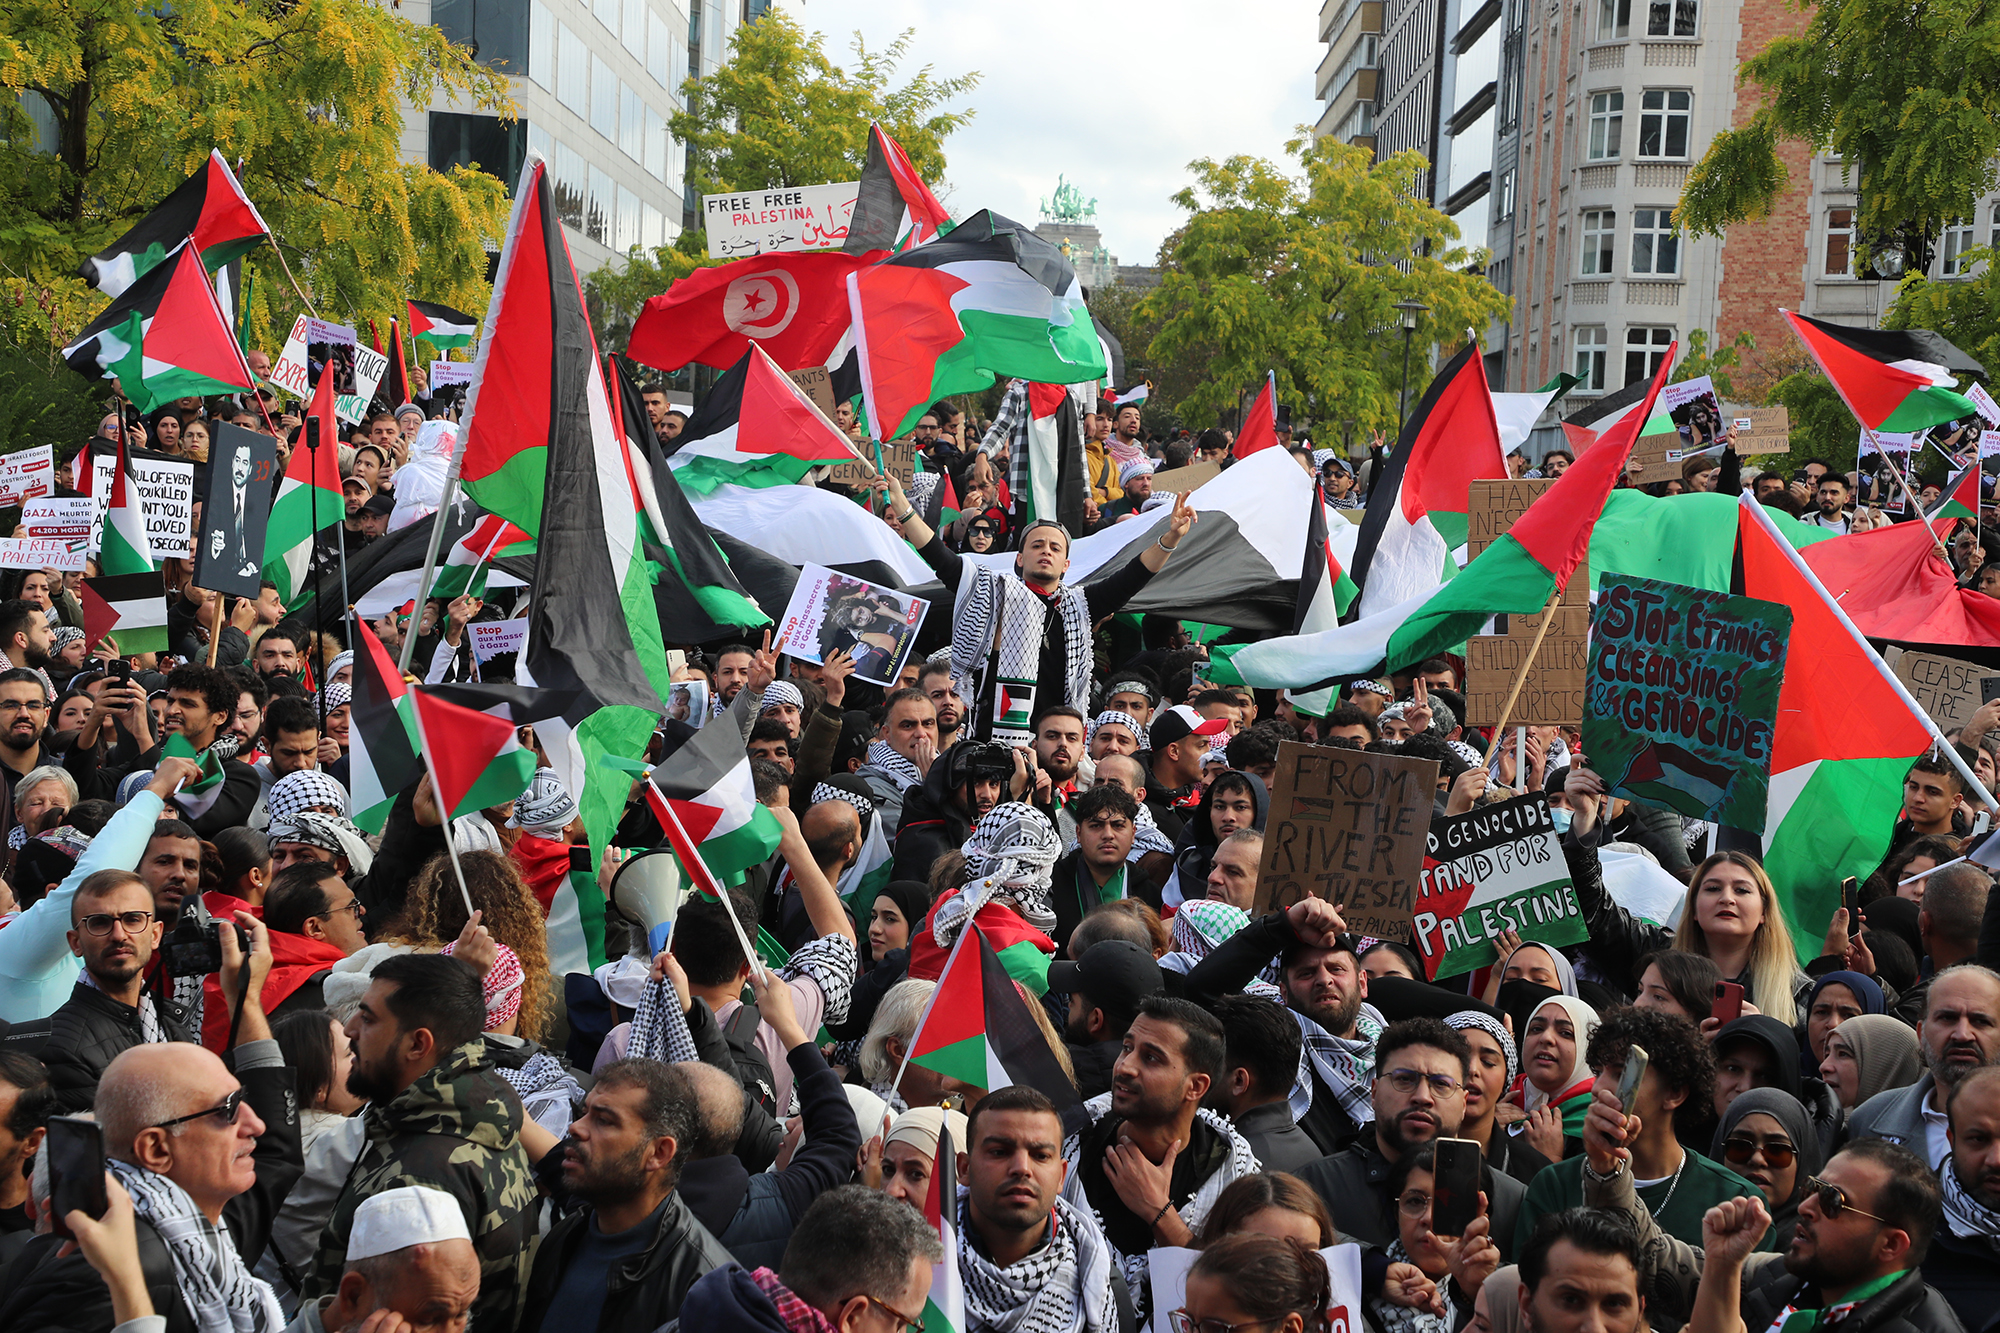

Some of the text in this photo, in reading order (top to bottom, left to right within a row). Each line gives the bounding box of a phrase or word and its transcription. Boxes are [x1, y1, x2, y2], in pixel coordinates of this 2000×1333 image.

[708, 192, 802, 213] FREE FREE
[732, 206, 814, 226] PALESTINA
[311, 321, 326, 330] Stop
[1974, 387, 1987, 400] Stop
[29, 449, 49, 457] FORCES
[892, 443, 916, 462] THE
[1635, 434, 1678, 453] ISRAEL
[1, 475, 34, 484] DESTROYED
[6, 466, 18, 475] 37
[97, 466, 115, 478] THE
[150, 471, 165, 484] OF
[165, 473, 192, 486] EVERY
[254, 460, 270, 482] 39
[30, 478, 41, 487] 23
[138, 487, 187, 501] YOU KILLED
[24, 509, 56, 518] GAZA
[60, 526, 89, 534] MORTS
[146, 518, 186, 534] LOVED
[18, 540, 63, 551] FREE
[1, 551, 82, 566] PALESTINE
[791, 578, 823, 647] aux massacres
[1601, 584, 1681, 646] STOP
[476, 627, 502, 635] Stop
[801, 618, 816, 642] Gaza
[1471, 640, 1588, 671] CHILD KILLERS
[1507, 670, 1551, 693] ARE
[1911, 659, 1979, 695] CEASE
[1469, 690, 1584, 722] TERRORISTS
[1594, 682, 1611, 717] &
[1293, 754, 1408, 803] FROM
[1343, 801, 1417, 836] THE
[1447, 799, 1551, 849] GENOCIDE
[1270, 821, 1395, 876] RIVER
[1419, 833, 1551, 900] TAND FOR
[1263, 873, 1302, 912] TO
[1413, 886, 1580, 958] PALESTINE
